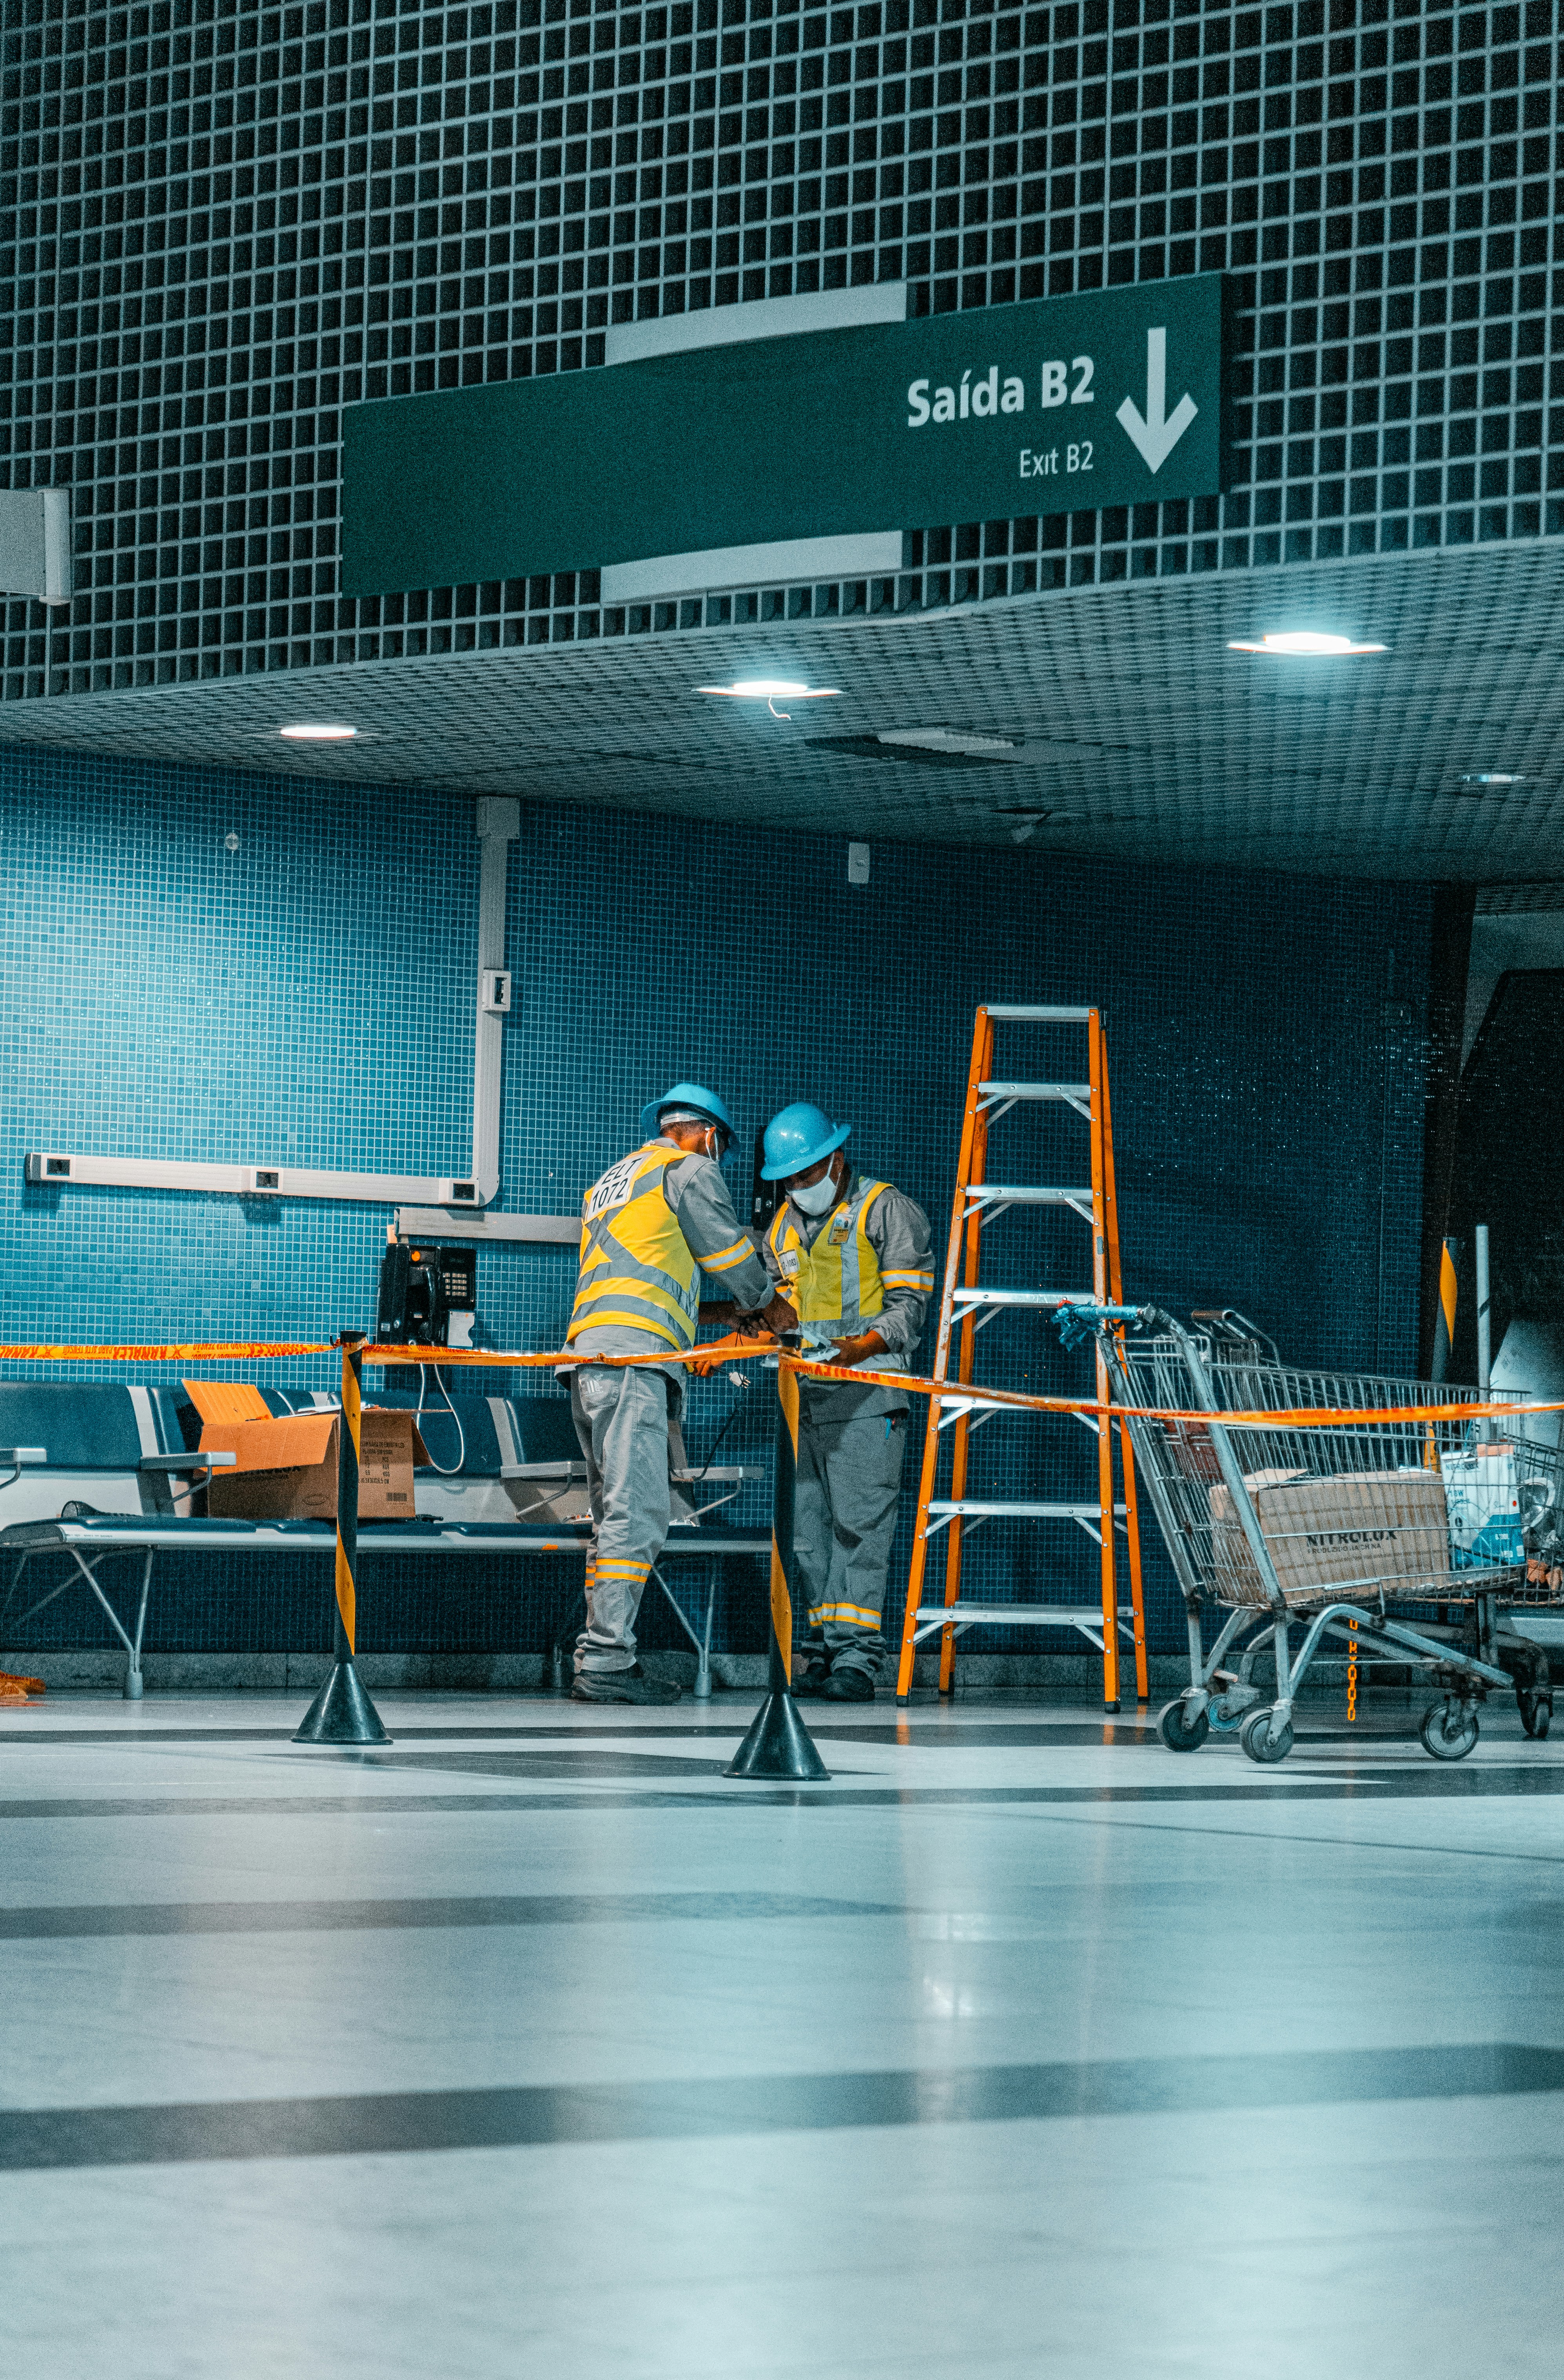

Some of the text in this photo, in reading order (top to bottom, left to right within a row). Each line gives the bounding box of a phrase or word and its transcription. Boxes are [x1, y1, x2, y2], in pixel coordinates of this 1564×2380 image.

[908, 355, 1094, 427] Saída B2
[1020, 440, 1093, 477] Exit B2
[601, 1157, 643, 1185] ELT
[592, 1178, 628, 1213] 1072
[1307, 1530, 1397, 1547] NITROLUX
